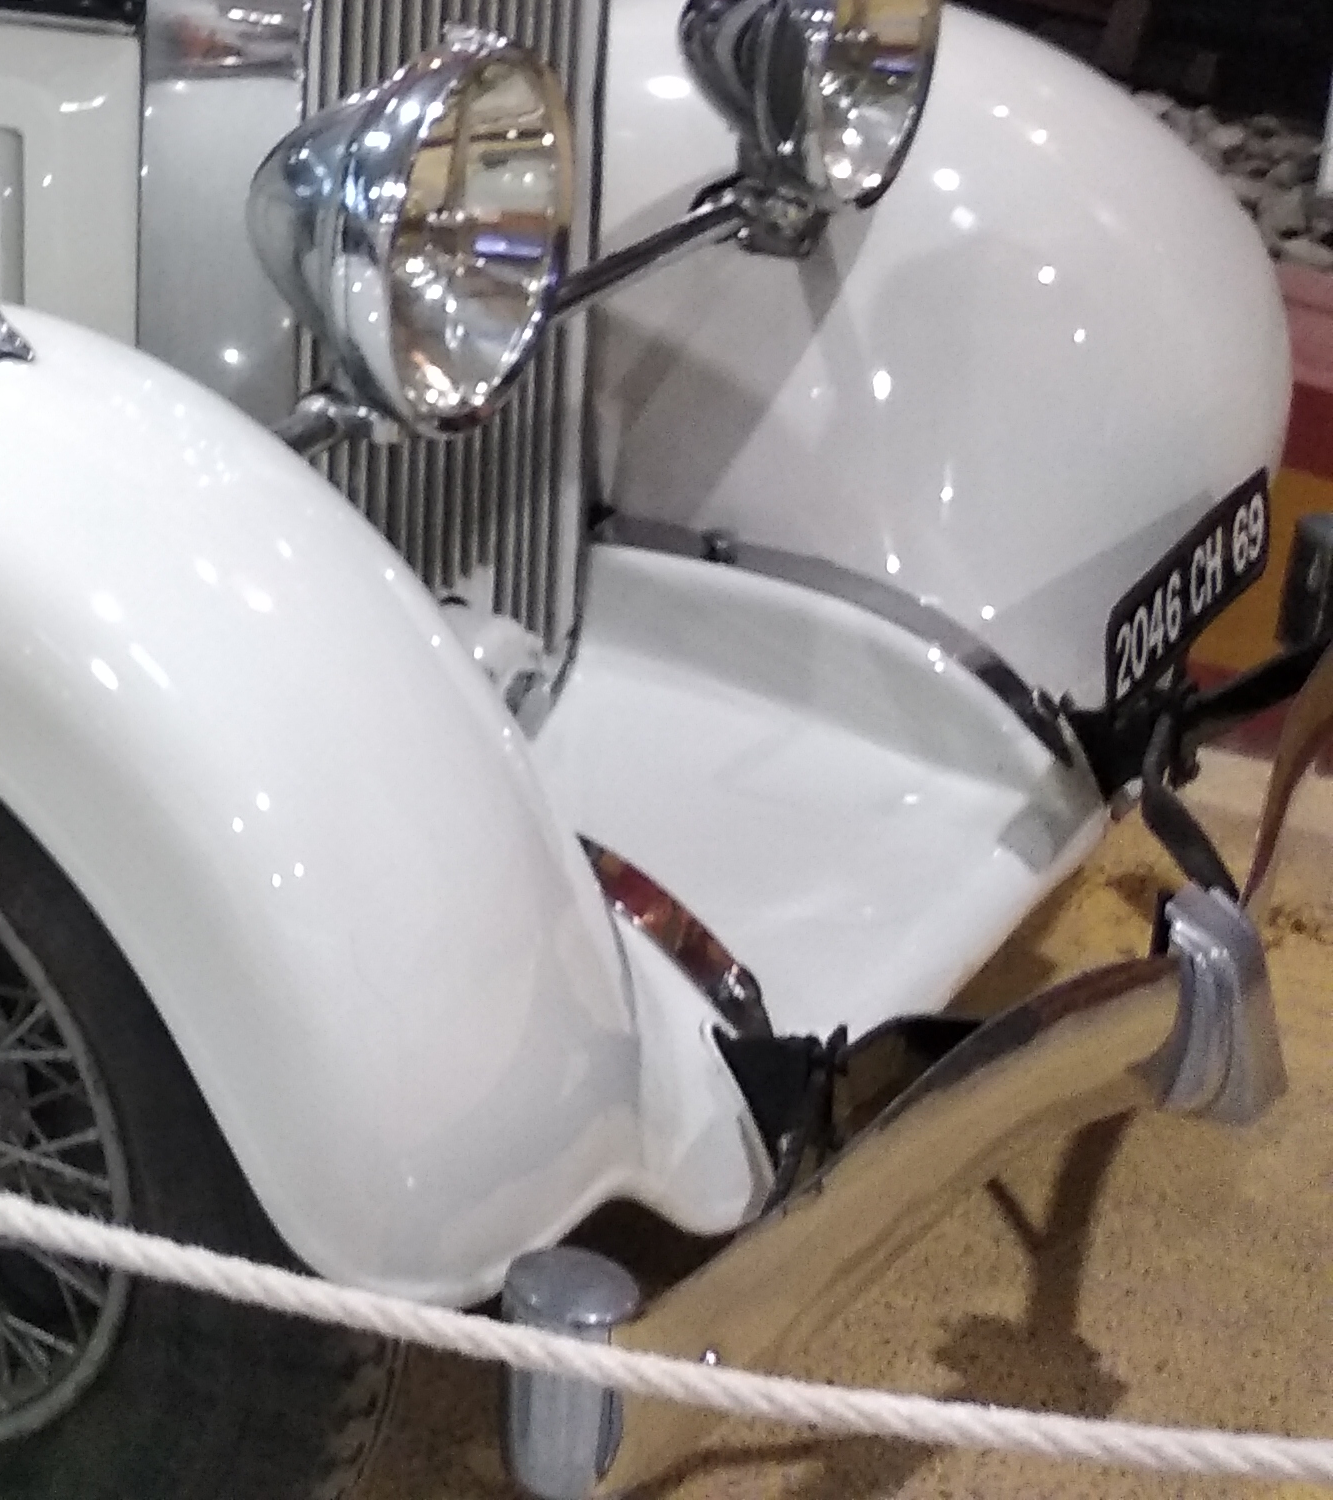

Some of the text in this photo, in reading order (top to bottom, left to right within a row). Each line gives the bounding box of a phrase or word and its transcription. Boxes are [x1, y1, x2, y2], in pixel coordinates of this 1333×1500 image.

[1115, 491, 1265, 701] 2046 CH 69
